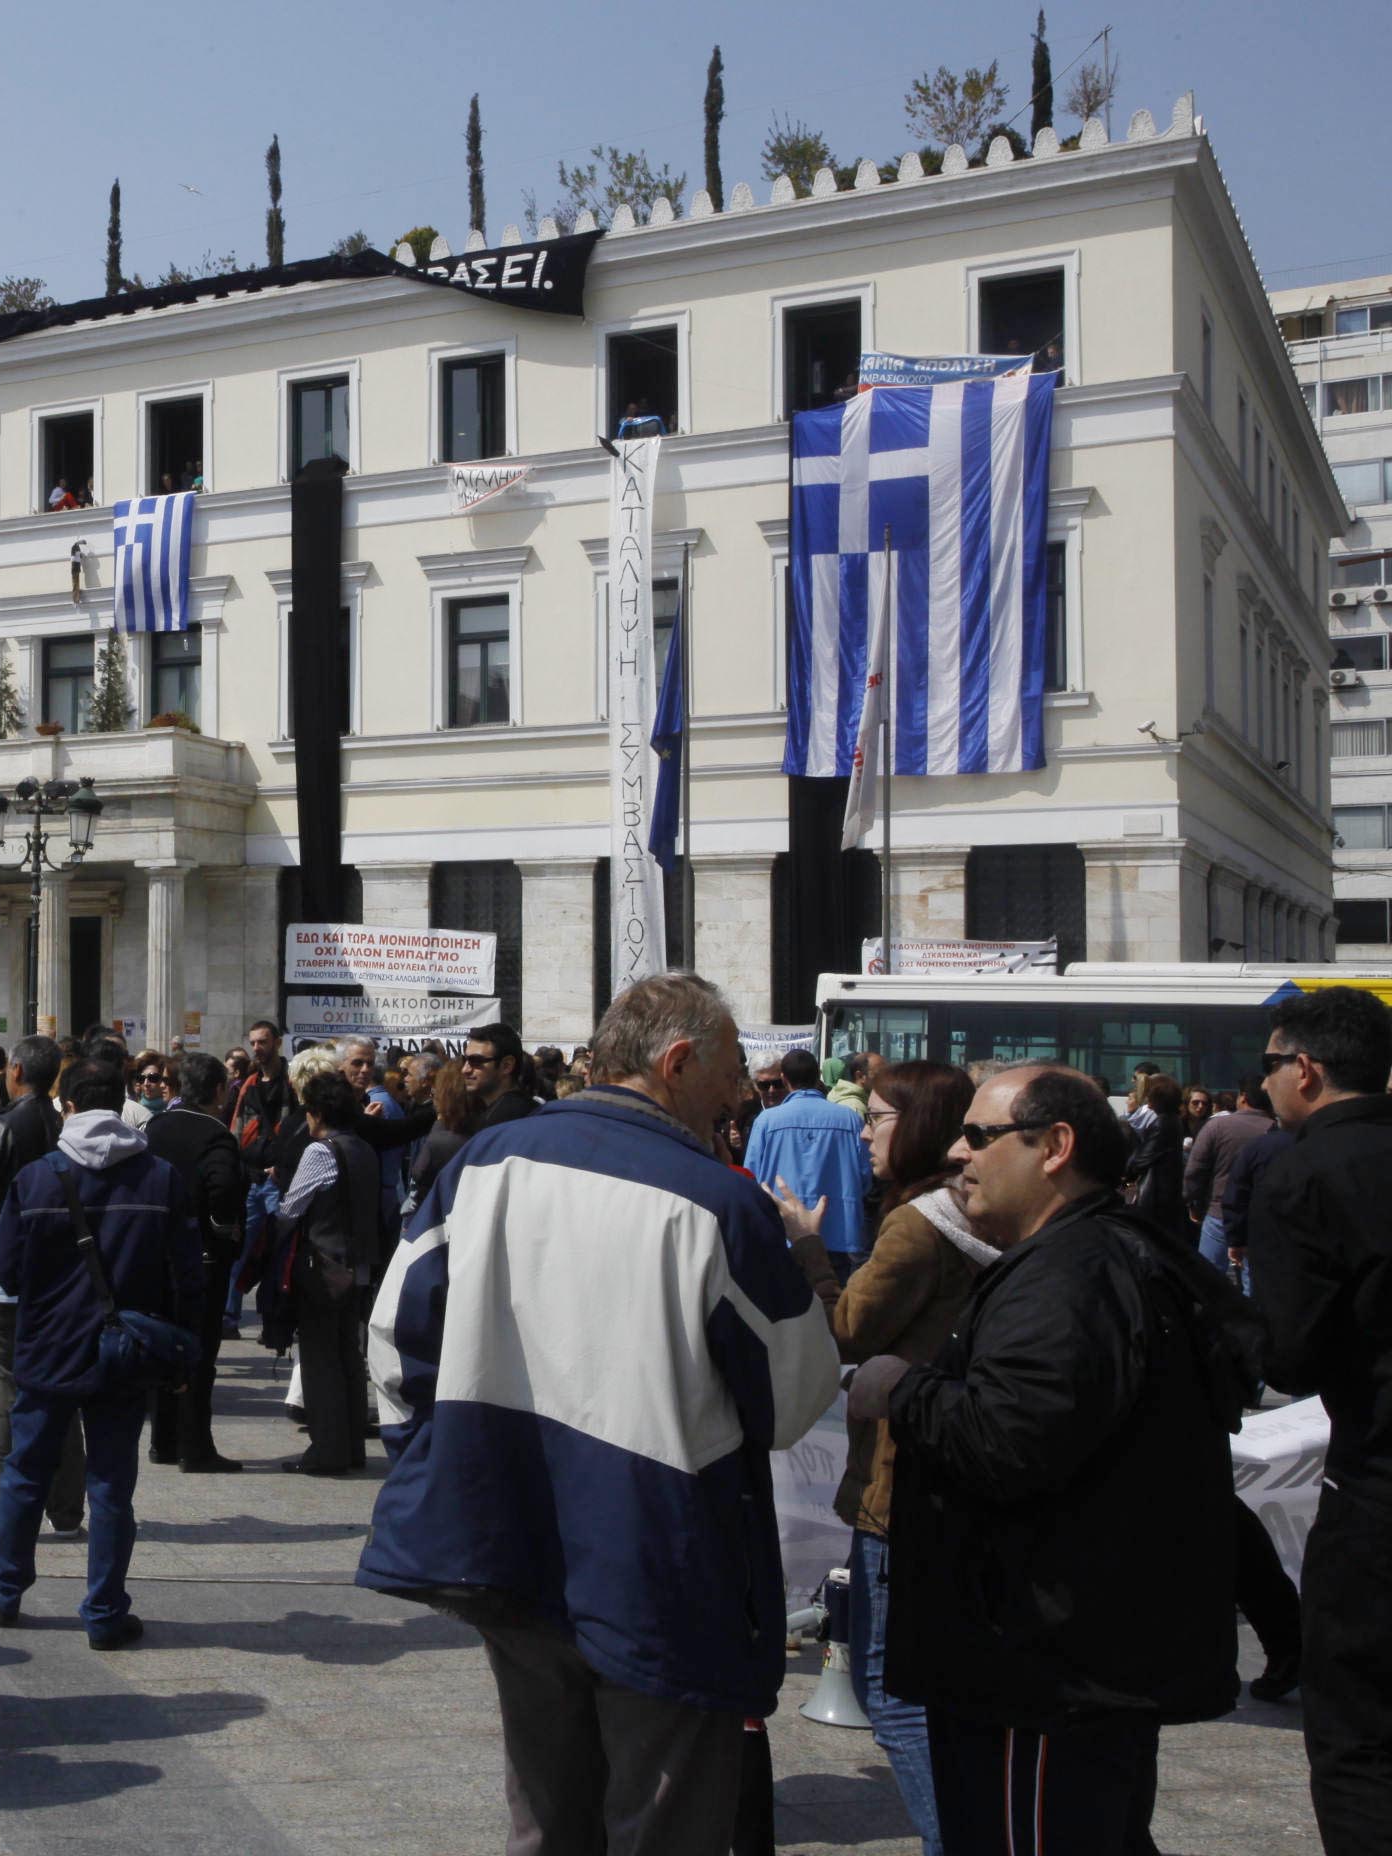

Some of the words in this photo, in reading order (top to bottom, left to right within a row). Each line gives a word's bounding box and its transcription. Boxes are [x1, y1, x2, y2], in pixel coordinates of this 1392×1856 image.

[914, 359, 996, 373] ΑΠΟΛΥΣΗ
[618, 442, 645, 677] ΚΑΤΑΛΗΨΗ
[296, 933, 319, 944] ΕΔΩ
[323, 933, 344, 944] ΚΑΙ
[347, 933, 375, 945] ΤΩΡΑ
[379, 934, 481, 950] ΜΟΝΙΜΟΠΟΙΗΣΗ
[314, 946, 337, 956] ΟΧΙ
[341, 948, 382, 957] ΑΛΛΟΝ
[386, 949, 459, 962] ΕΜΠΑΙΓΜΟ
[296, 959, 335, 968] ΣΤΑΘΕΡΗ
[337, 959, 351, 968] ΚΑΙ
[353, 960, 385, 969] ΜΟΝΙΜΗ
[387, 962, 426, 971] ΔΟΥΛΕΙΑ
[428, 964, 444, 973] ΓΙΑ
[447, 965, 479, 975] ΟΛΟΥΣ
[898, 960, 914, 968] ΟΧΙ
[916, 960, 950, 968] ΝΟΜΙΚΟ
[395, 974, 436, 984] ΑΛΛΟΔΑΠΩΝ
[444, 977, 480, 987] ΑΘΗΝΑΙΩΝ
[311, 996, 336, 1008] ΝΑΙ
[341, 997, 370, 1008] ΣΤΗΝ
[375, 998, 475, 1010] ΤΑΚΤΟΠΟΙΗΣΗ
[322, 1011, 349, 1022] ΟΧΙ
[352, 1012, 375, 1023] ΣΤΙΣ
[379, 1013, 460, 1025] ΑΠΟΛΥΣΕΙΣ
